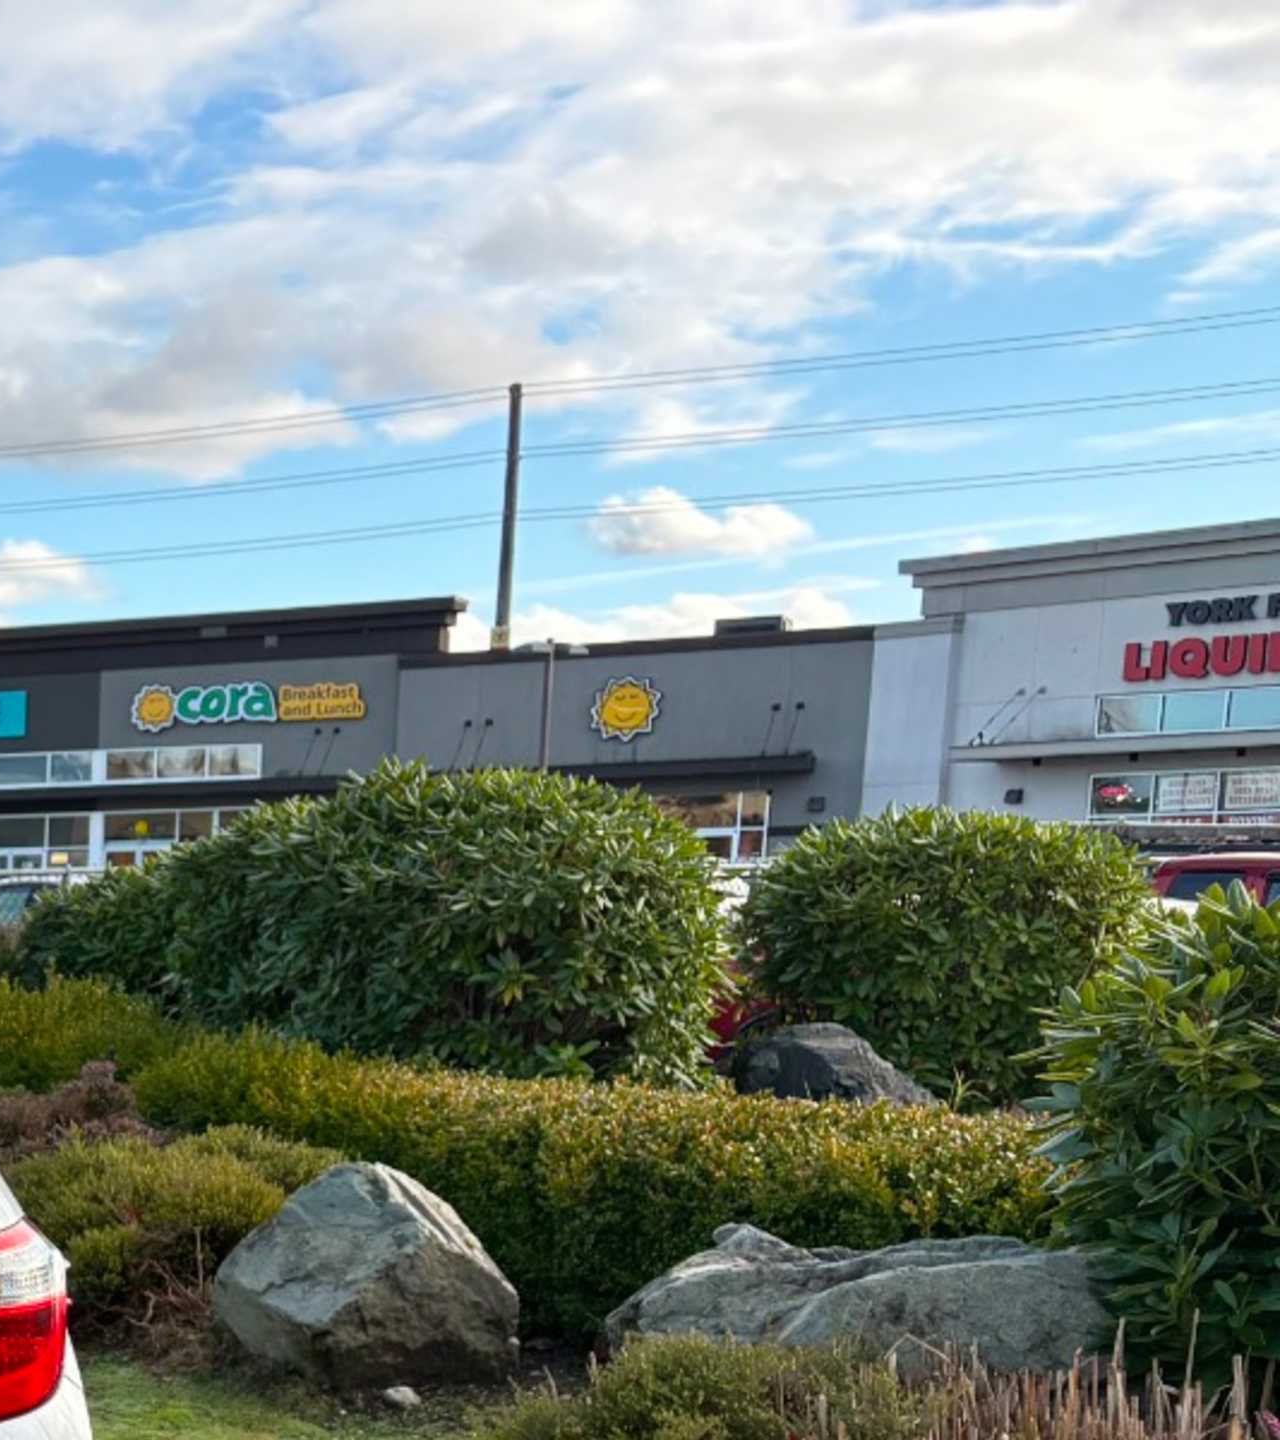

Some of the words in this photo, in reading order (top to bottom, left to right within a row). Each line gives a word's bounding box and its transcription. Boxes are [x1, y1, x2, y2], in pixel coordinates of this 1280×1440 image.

[1166, 595, 1259, 627] YORK
[175, 681, 277, 723] cora
[282, 685, 357, 701] Breakfast
[283, 702, 312, 716] and
[316, 700, 363, 716] Lunch
